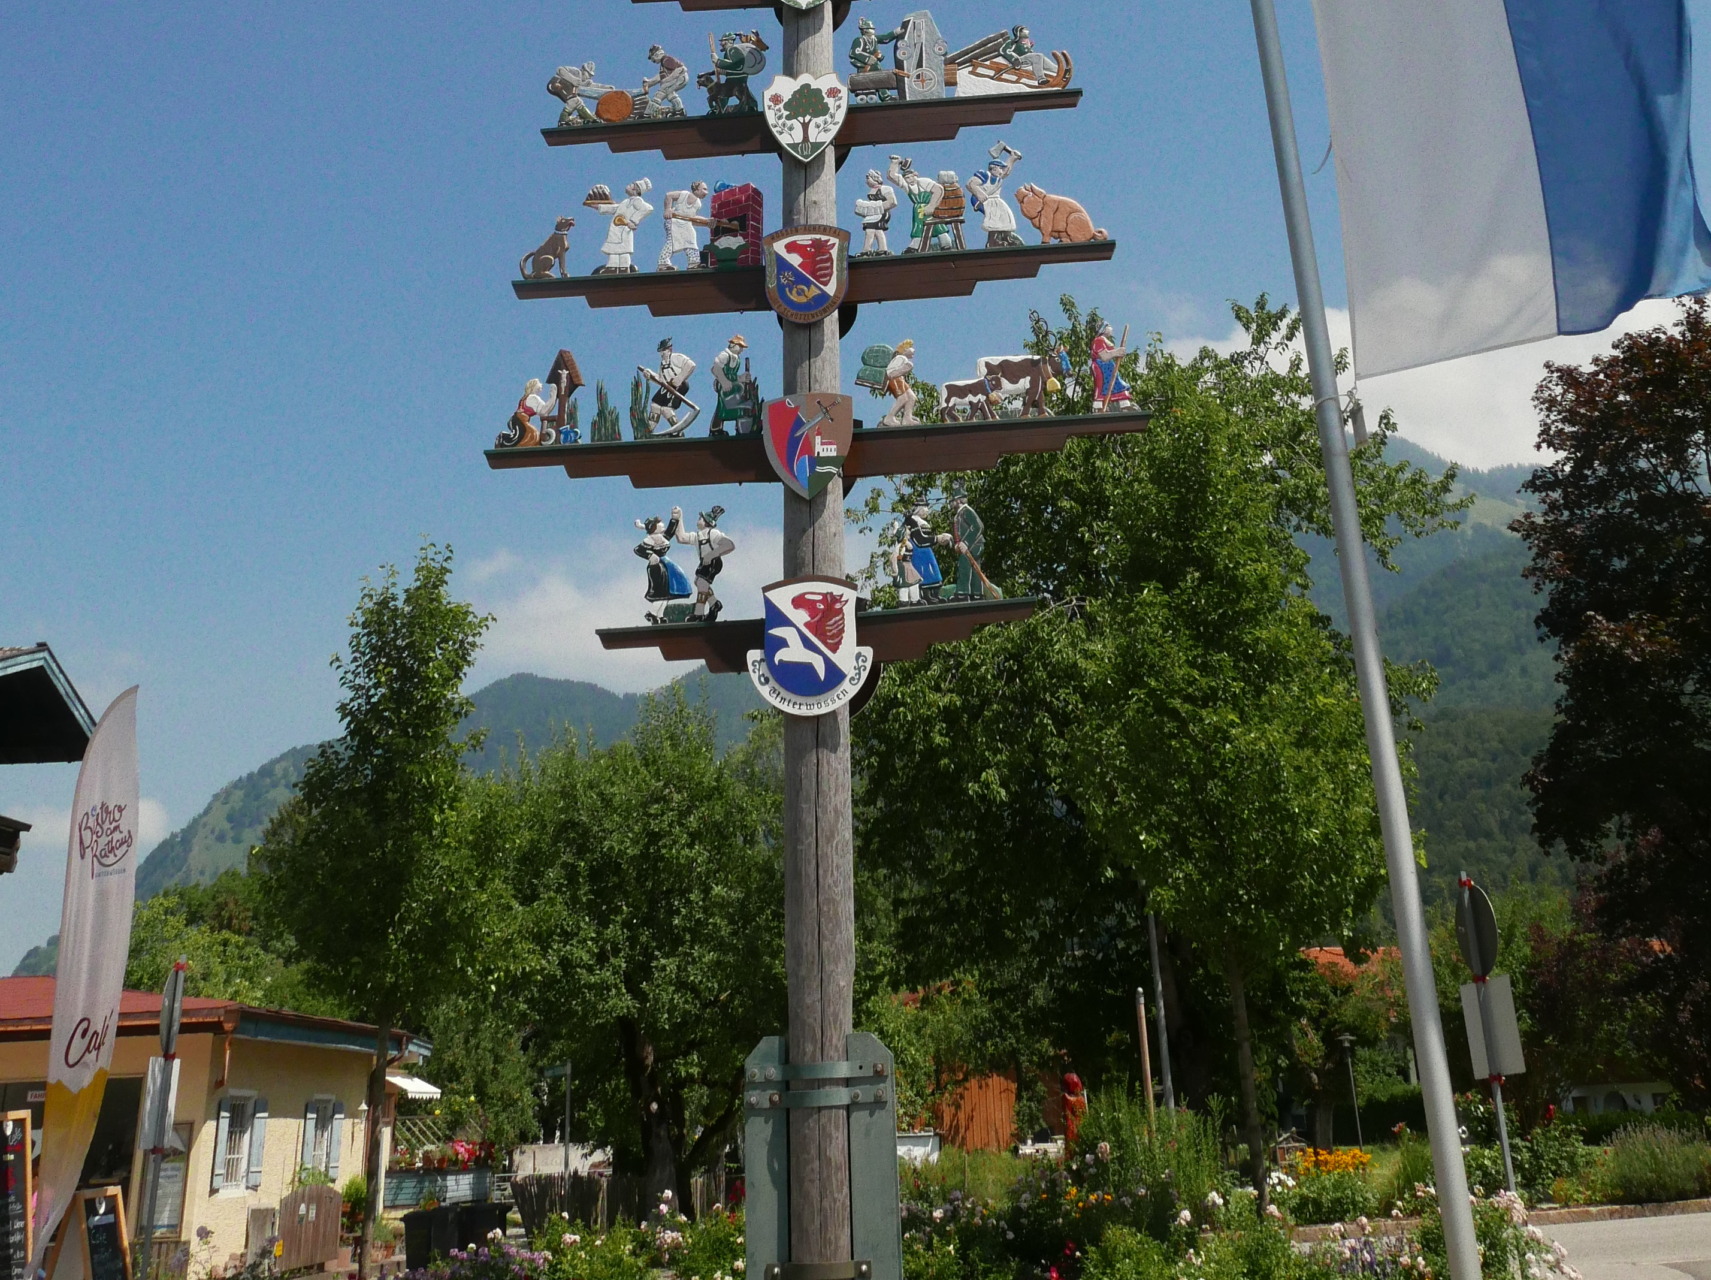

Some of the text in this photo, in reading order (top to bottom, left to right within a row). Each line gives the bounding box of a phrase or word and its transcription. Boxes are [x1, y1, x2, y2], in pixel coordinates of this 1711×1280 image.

[768, 686, 849, 710] Unterwössen
[78, 800, 127, 860] Bistro
[91, 829, 133, 880] Rathaus
[105, 824, 123, 837] am
[64, 1008, 114, 1069] Café
